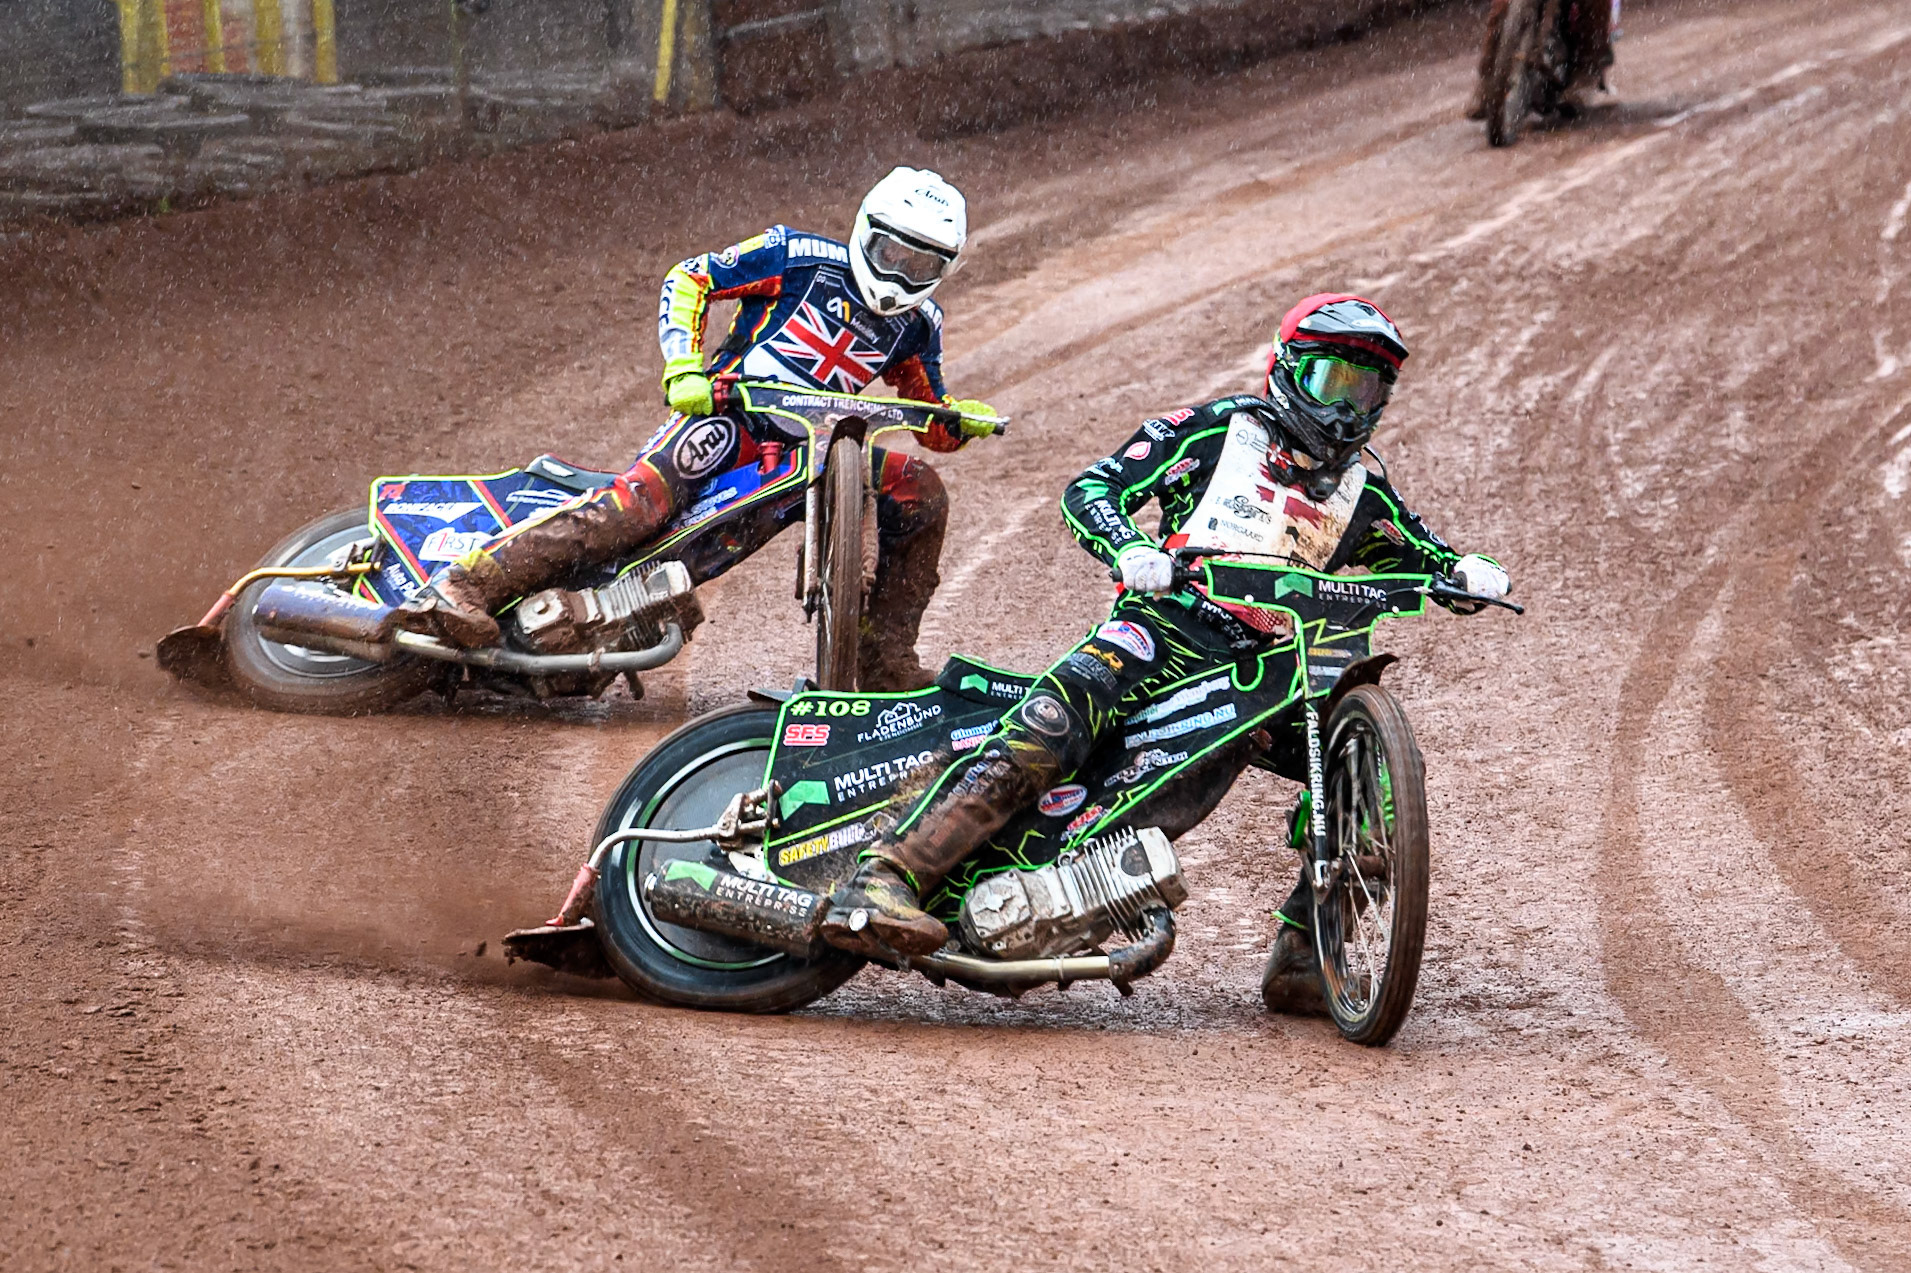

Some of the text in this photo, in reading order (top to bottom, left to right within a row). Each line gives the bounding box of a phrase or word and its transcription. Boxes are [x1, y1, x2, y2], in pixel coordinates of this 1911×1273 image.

[782, 394, 831, 408] CONTRACT
[887, 408, 904, 421] LTD
[1318, 579, 1360, 596] MULTI
[991, 681, 1023, 695] MULTI
[790, 700, 871, 717] #108
[785, 724, 830, 741] SFS
[857, 705, 942, 743] FLADENBUND
[833, 750, 934, 791] MULTI TAG
[720, 874, 813, 908] MULTI TAG
